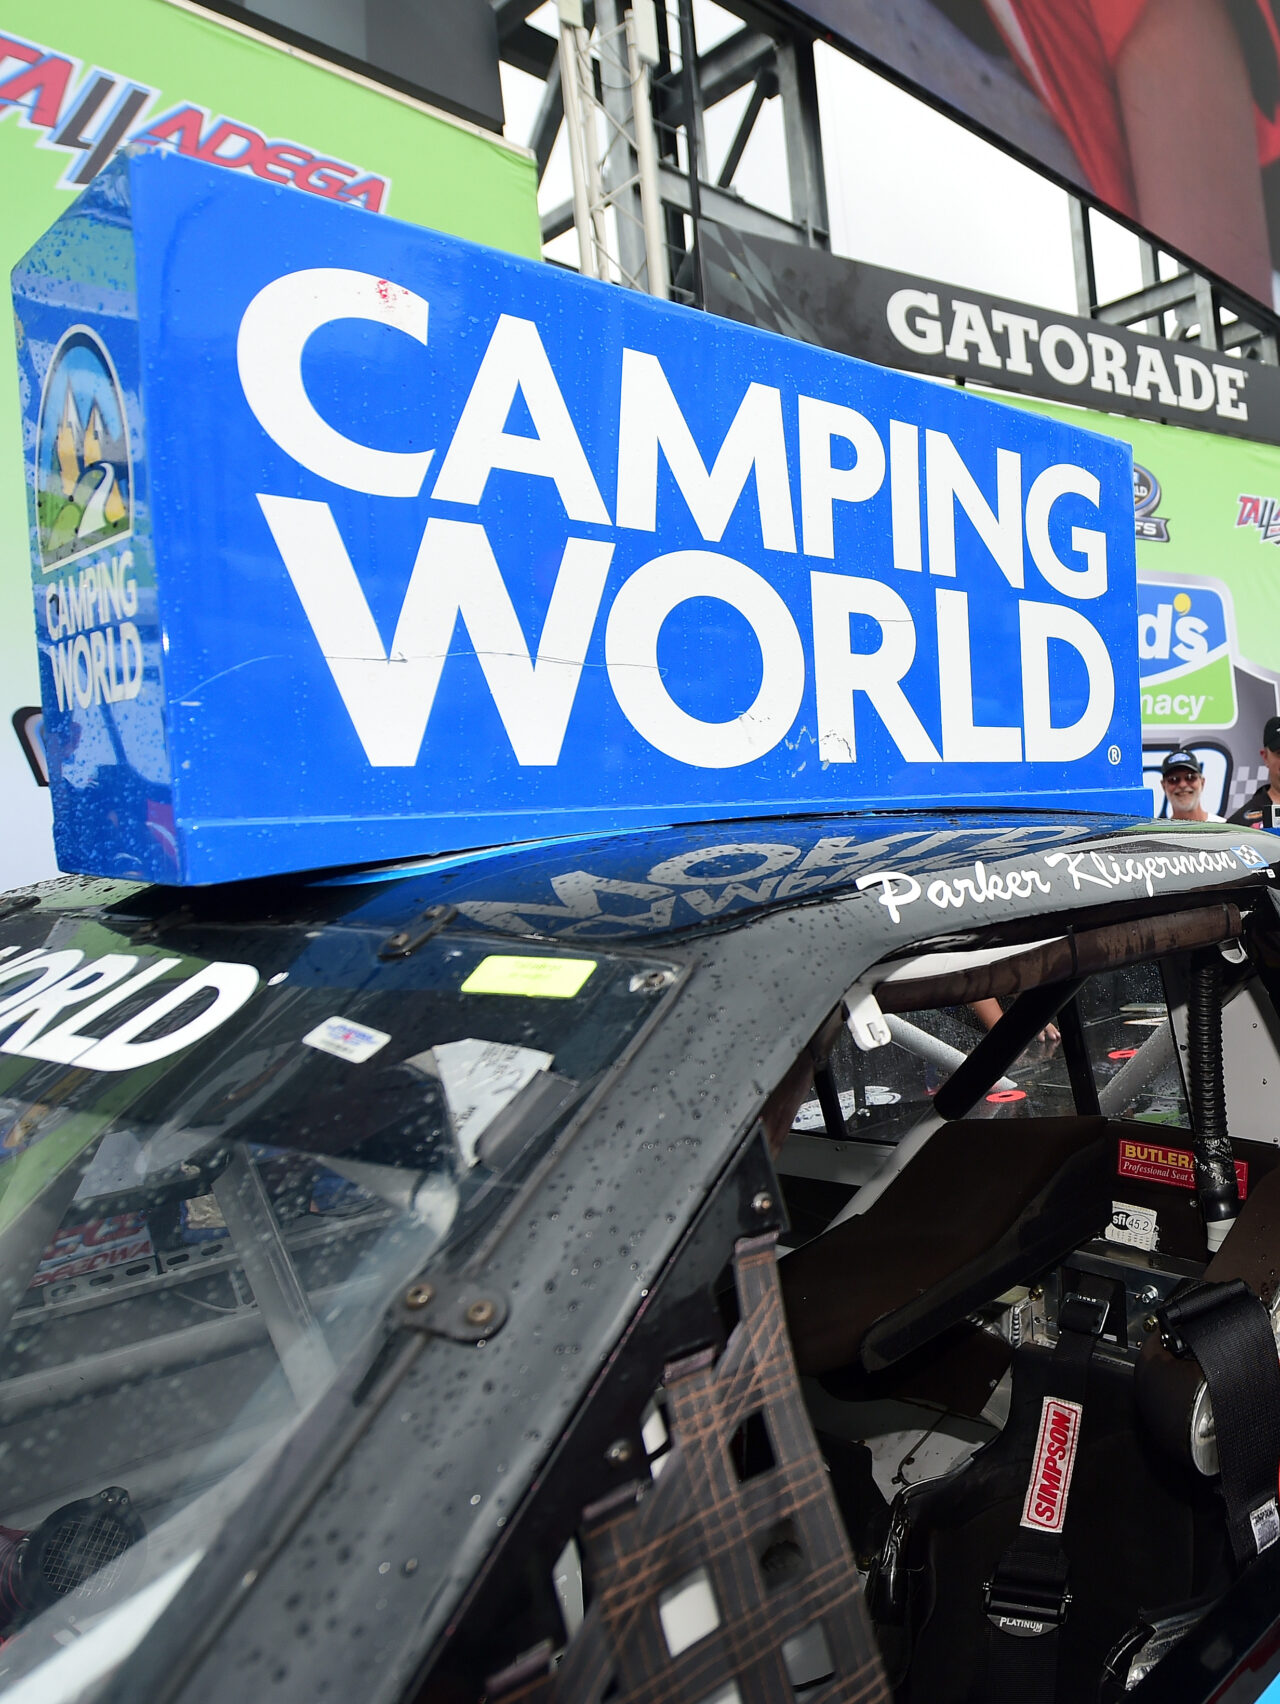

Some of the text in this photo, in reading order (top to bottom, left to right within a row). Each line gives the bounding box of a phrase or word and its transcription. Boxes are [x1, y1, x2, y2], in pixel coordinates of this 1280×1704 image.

[887, 287, 1249, 421] GATORADE
[237, 268, 1108, 599] CAMPING
[46, 551, 138, 638] CAMPING
[256, 493, 1115, 768] WORLD
[50, 622, 143, 713] WORLD
[857, 861, 1050, 924] Parker
[1046, 848, 1237, 897] Kligerman
[0, 946, 260, 1072] ORLD
[1123, 1161, 1170, 1178] Professional
[1170, 1169, 1188, 1182] Seat
[1125, 1144, 1197, 1169] BUTLER
[1112, 1213, 1149, 1232] sfi 45.2
[1034, 1410, 1071, 1522] SIMPSON
[999, 1616, 1043, 1631] PLATINUM
